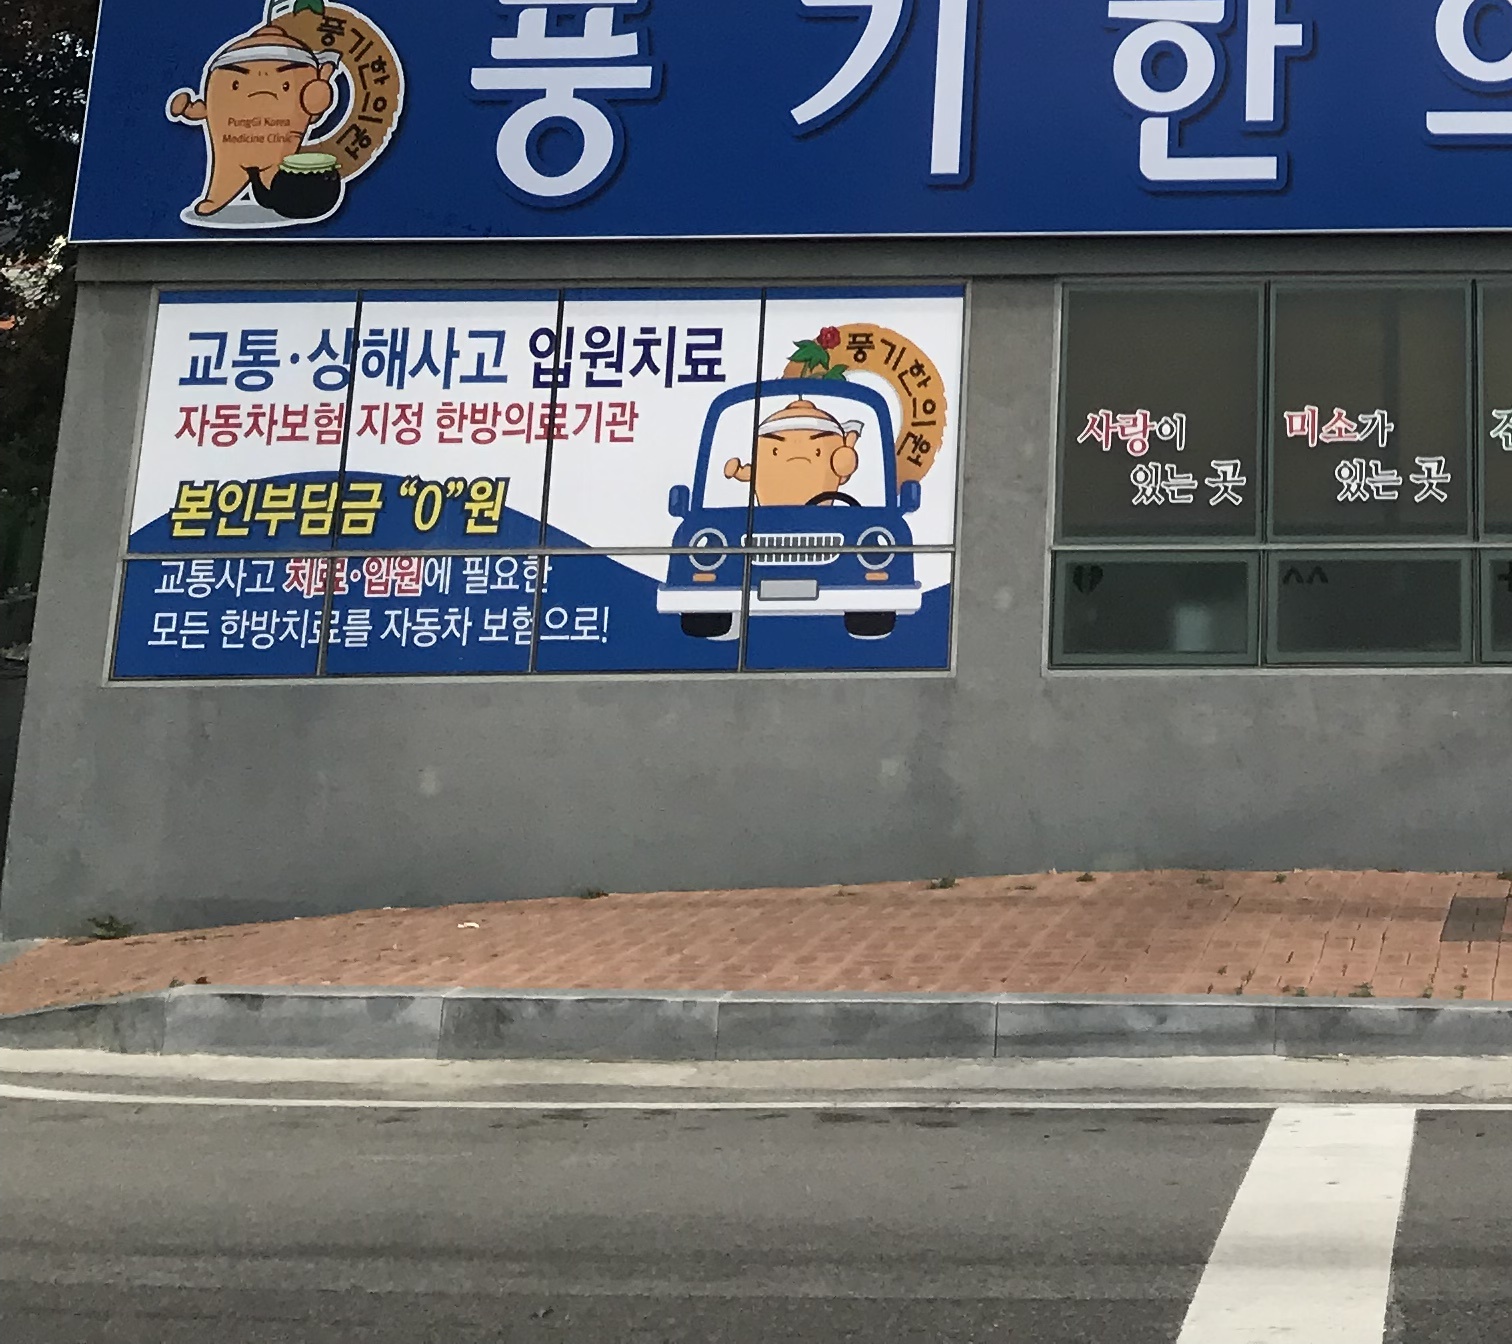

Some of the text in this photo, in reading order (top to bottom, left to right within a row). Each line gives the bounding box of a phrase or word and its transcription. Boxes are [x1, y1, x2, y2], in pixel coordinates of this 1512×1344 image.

[316, 15, 391, 160] 풍기한의원
[528, 325, 727, 391] 입원치료
[174, 399, 639, 448] 자동차보험 지정 한방의료기관
[846, 332, 937, 468] 풍기한의원
[1076, 408, 1187, 457] 사랑이
[1283, 405, 1395, 447] 미소가
[1130, 458, 1247, 506] 있는 곳
[1334, 456, 1451, 503] 있는 곳
[170, 480, 384, 537] 본인부담금
[153, 557, 276, 599] 교통사고
[462, 555, 553, 596] 필요한
[147, 611, 211, 650] 모든
[220, 608, 373, 649] 한방치료를
[379, 608, 472, 648] 자동차
